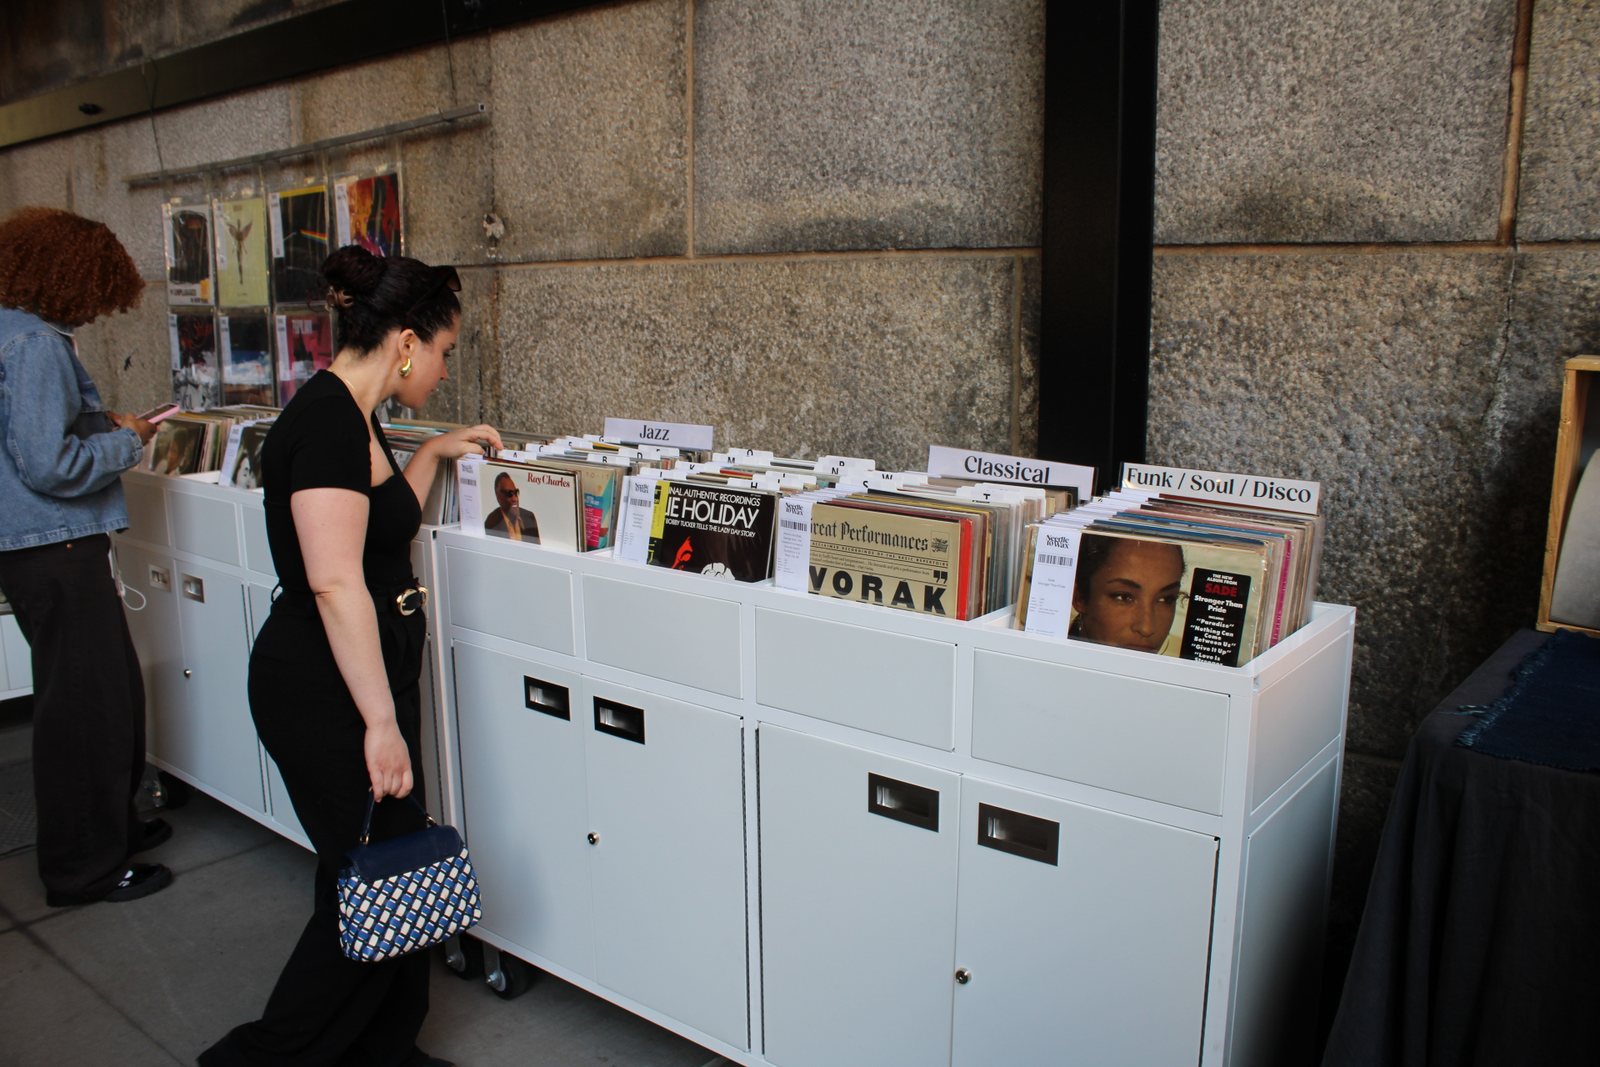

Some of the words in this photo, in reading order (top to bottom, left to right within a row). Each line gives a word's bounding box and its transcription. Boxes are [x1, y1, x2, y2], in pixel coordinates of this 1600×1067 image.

[639, 424, 670, 441] Jazz
[831, 467, 839, 475] N
[964, 455, 1050, 484] Classical
[527, 472, 542, 484] Ray
[542, 475, 570, 488] Charles
[1127, 467, 1173, 487] Funk
[1177, 473, 1186, 490] /
[1190, 474, 1234, 495] Soul
[1239, 479, 1248, 496] /
[1253, 480, 1311, 503] Disco
[683, 489, 719, 501] AUTHENTIC
[720, 493, 761, 507] RECORDINGS
[665, 497, 680, 518] IE
[681, 498, 759, 529] HOLIDAY
[680, 520, 696, 529] TUCKER
[696, 523, 708, 531] TELLS
[709, 524, 717, 532] THE
[718, 526, 731, 535] LADY
[731, 528, 740, 536] DAY
[740, 530, 756, 538] STORY
[810, 518, 837, 537] reat
[841, 521, 928, 551] Performances
[1046, 534, 1069, 543] Needle
[1054, 540, 1069, 549] Wax
[1205, 583, 1238, 597] SADE
[1194, 595, 1225, 606] Stronger
[1225, 600, 1243, 609] Than
[1207, 604, 1227, 614] Pride
[1194, 636, 1222, 646] Between
[1204, 632, 1222, 640] Come
